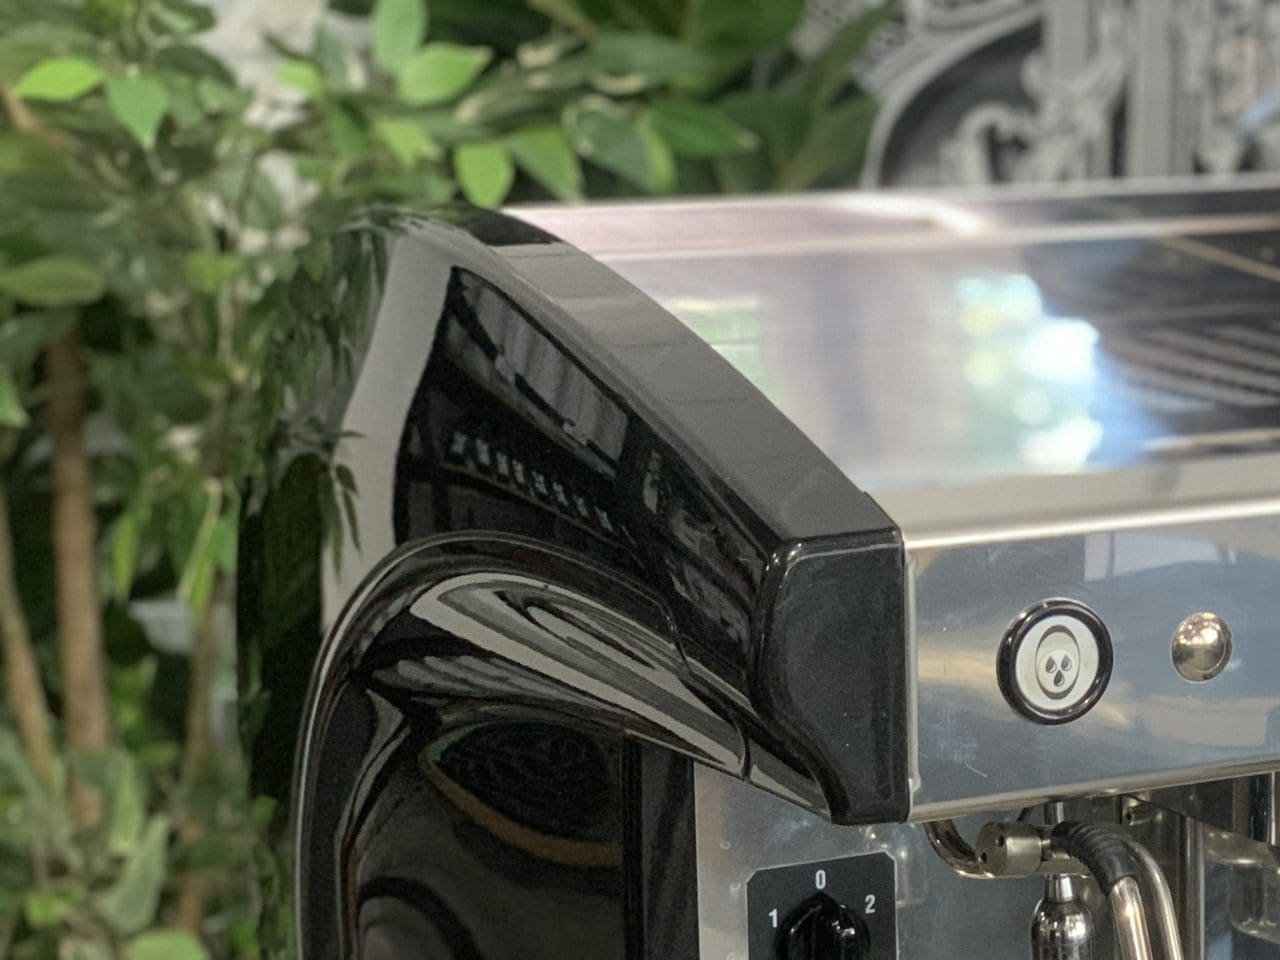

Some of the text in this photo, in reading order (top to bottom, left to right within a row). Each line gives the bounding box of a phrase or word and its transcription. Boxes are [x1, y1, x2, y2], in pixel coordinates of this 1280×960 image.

[815, 870, 826, 889] 0
[865, 894, 876, 914] 2
[769, 908, 778, 928] 1
